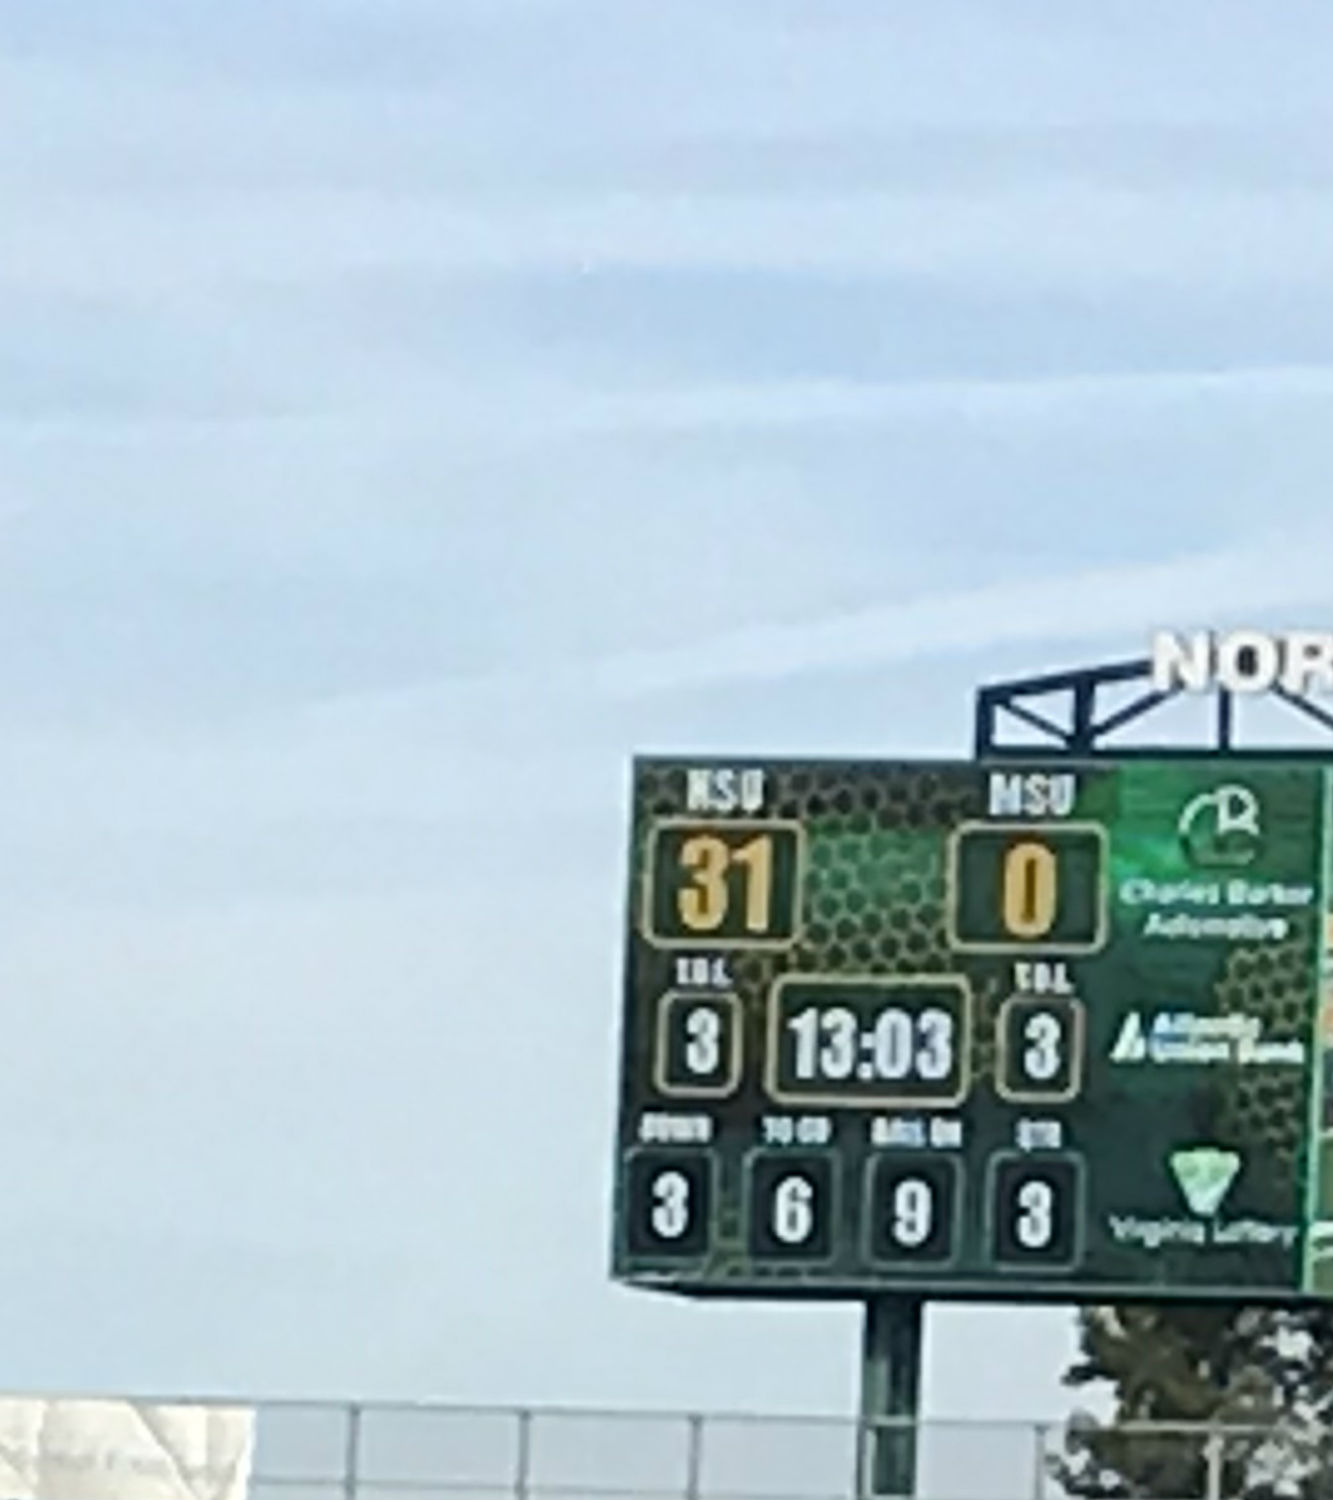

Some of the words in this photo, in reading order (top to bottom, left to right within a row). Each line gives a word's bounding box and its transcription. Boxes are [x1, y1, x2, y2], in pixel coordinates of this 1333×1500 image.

[989, 773, 1076, 816] MSU
[677, 834, 773, 932] 31
[1004, 841, 1056, 937] 0
[686, 1008, 720, 1075] 3
[788, 1006, 952, 1080] 13:03
[1024, 1012, 1061, 1080] 3
[652, 1171, 689, 1239] 3
[773, 1176, 813, 1244] 6
[892, 1179, 932, 1247] 9
[1016, 1180, 1053, 1249] 3
